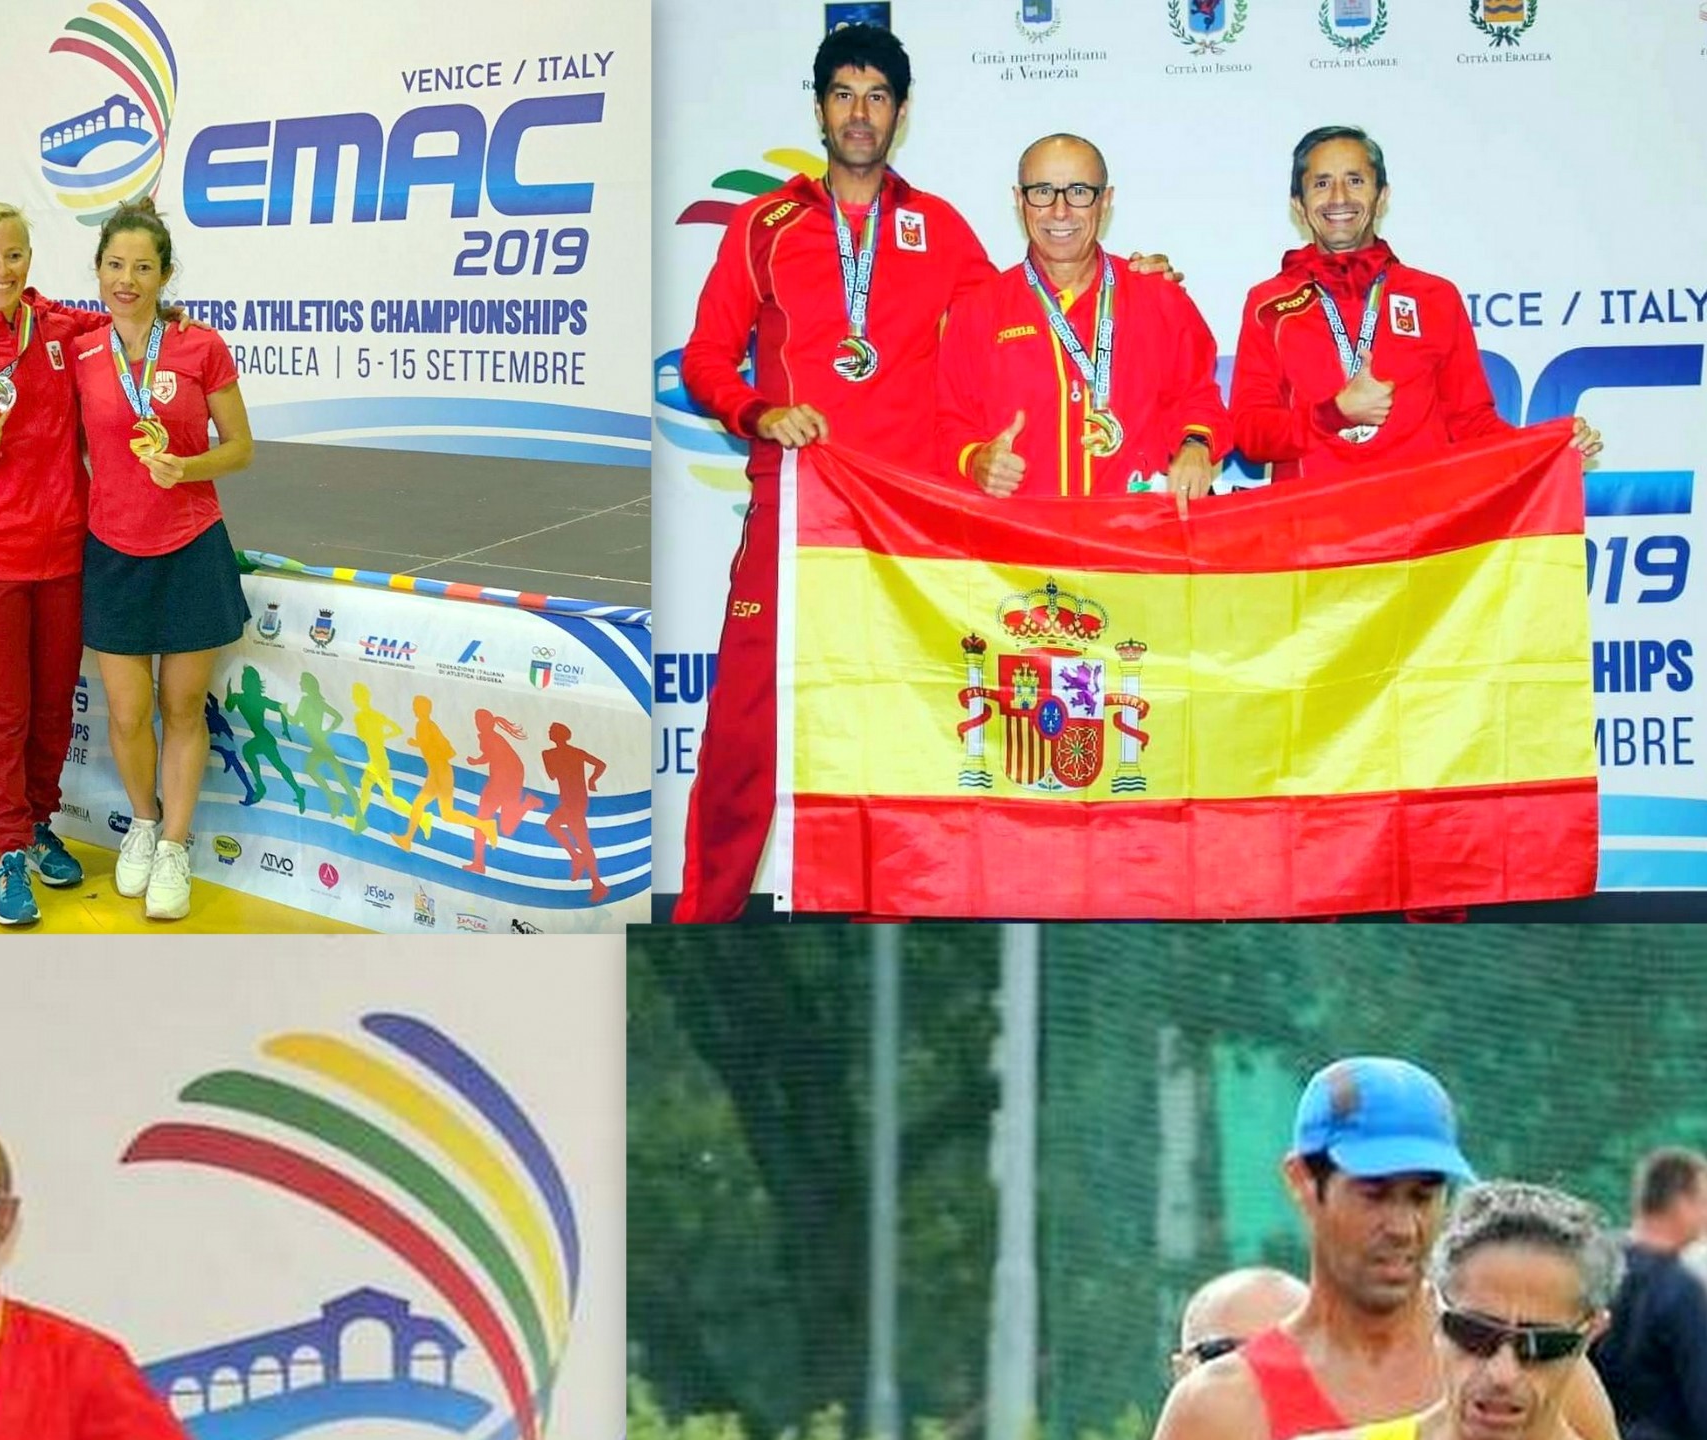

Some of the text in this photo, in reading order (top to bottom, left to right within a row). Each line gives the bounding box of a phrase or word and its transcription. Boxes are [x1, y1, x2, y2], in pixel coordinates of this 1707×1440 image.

[971, 50, 1108, 67] Città metropolitana
[401, 62, 503, 93] VENICE
[536, 51, 615, 83] ITALY
[1000, 65, 1079, 82] di Venezia
[182, 92, 606, 229] EMAC
[453, 227, 590, 277] 2019
[243, 298, 588, 336] ATHLETICS CHAMPIONSHIPS
[425, 349, 587, 386] SETTEMBRE
[731, 600, 762, 617] ESP
[364, 636, 417, 661] EMA
[554, 663, 585, 676] CONI
[260, 852, 294, 872] ATVO
